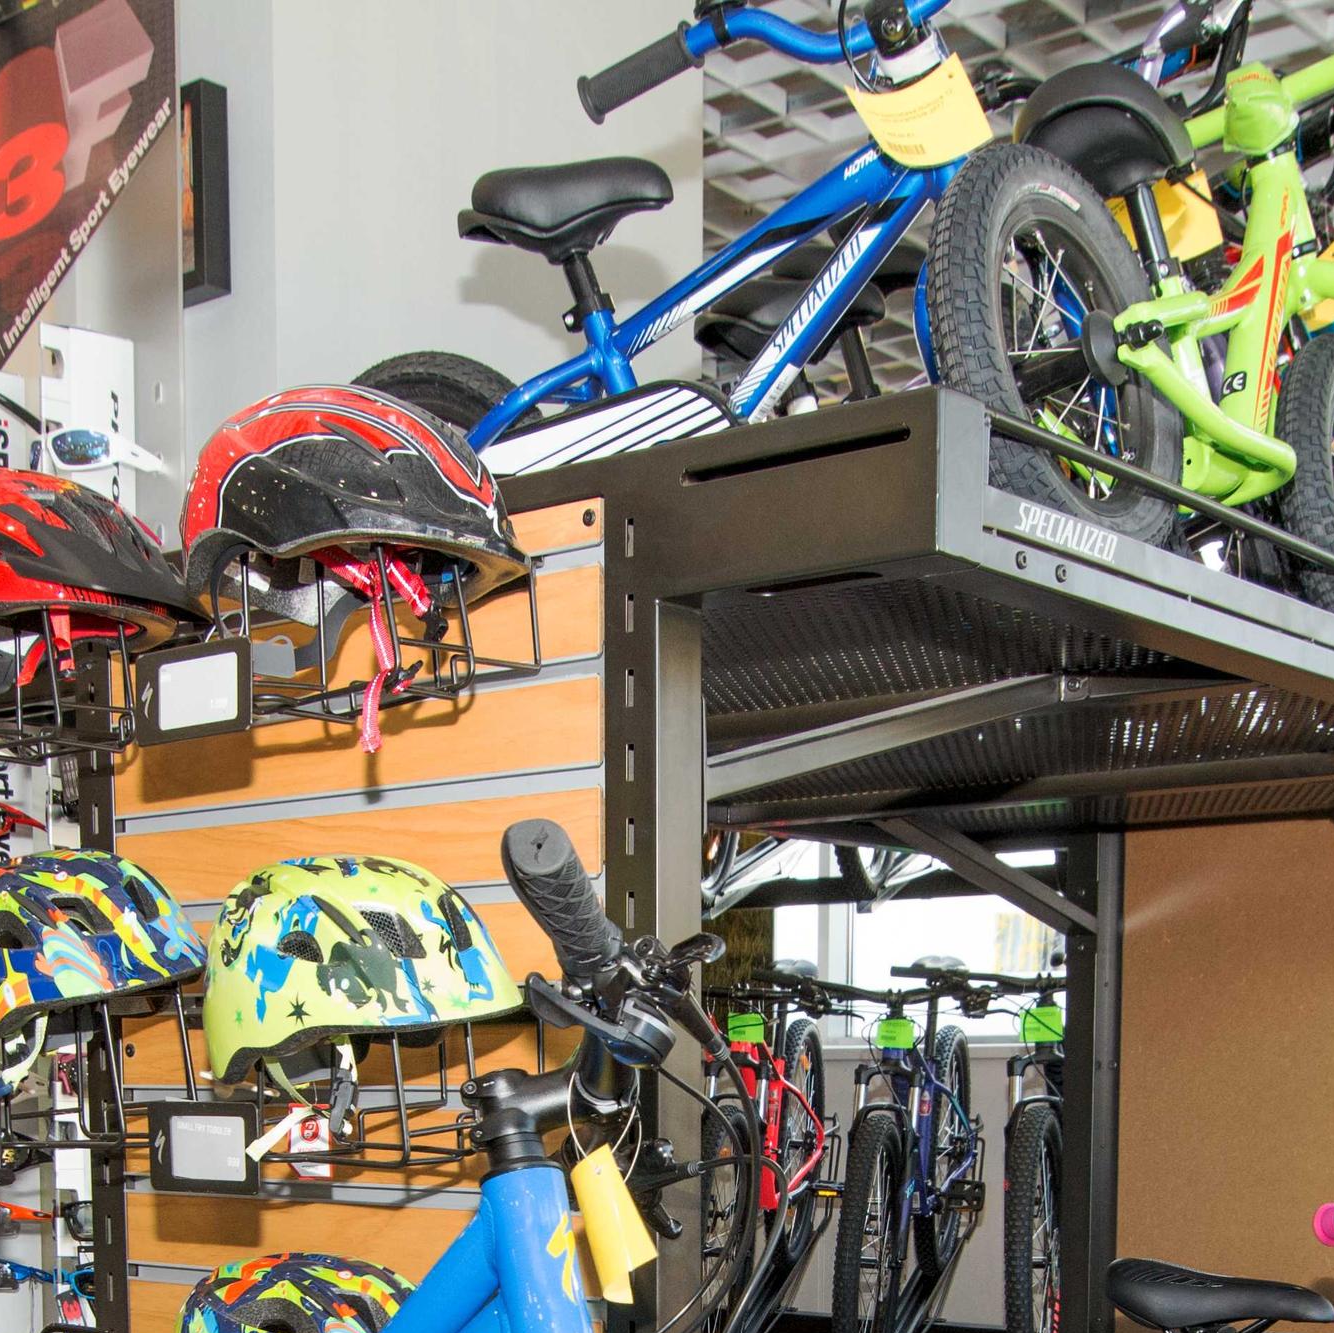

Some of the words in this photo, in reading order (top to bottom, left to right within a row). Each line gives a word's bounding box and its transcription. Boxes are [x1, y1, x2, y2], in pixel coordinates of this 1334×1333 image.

[3, 248, 71, 350] Intelligent
[69, 189, 111, 254] Sport
[107, 97, 172, 196] Eyewear
[772, 233, 863, 355] SPECIALIZED
[1014, 502, 1118, 562] SPECIALIZED
